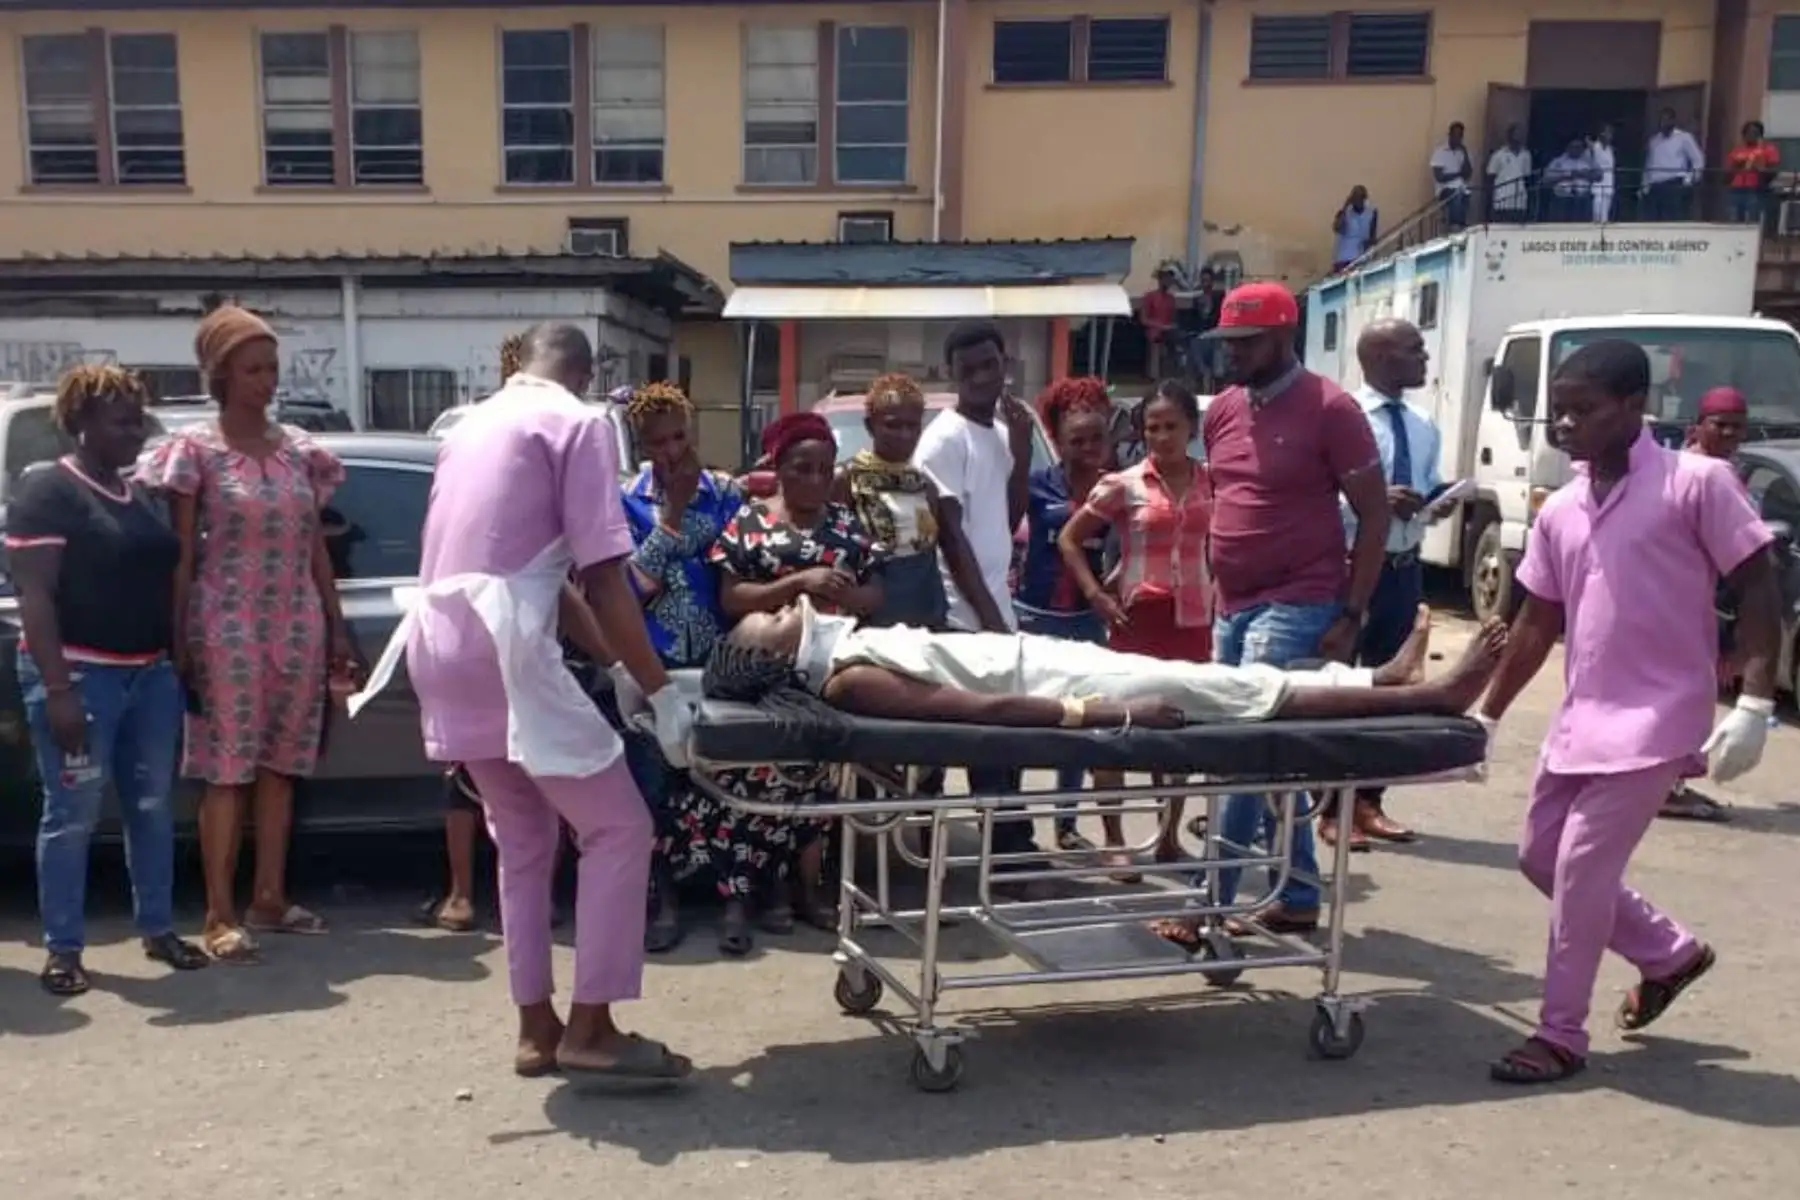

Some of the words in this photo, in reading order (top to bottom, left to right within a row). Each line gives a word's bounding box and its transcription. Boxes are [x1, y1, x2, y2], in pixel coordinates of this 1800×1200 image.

[1522, 240, 1556, 252] LAGOS
[1559, 240, 1587, 252] STATE
[1618, 240, 1664, 252] CONTROL
[1668, 239, 1710, 252] AGENCY
